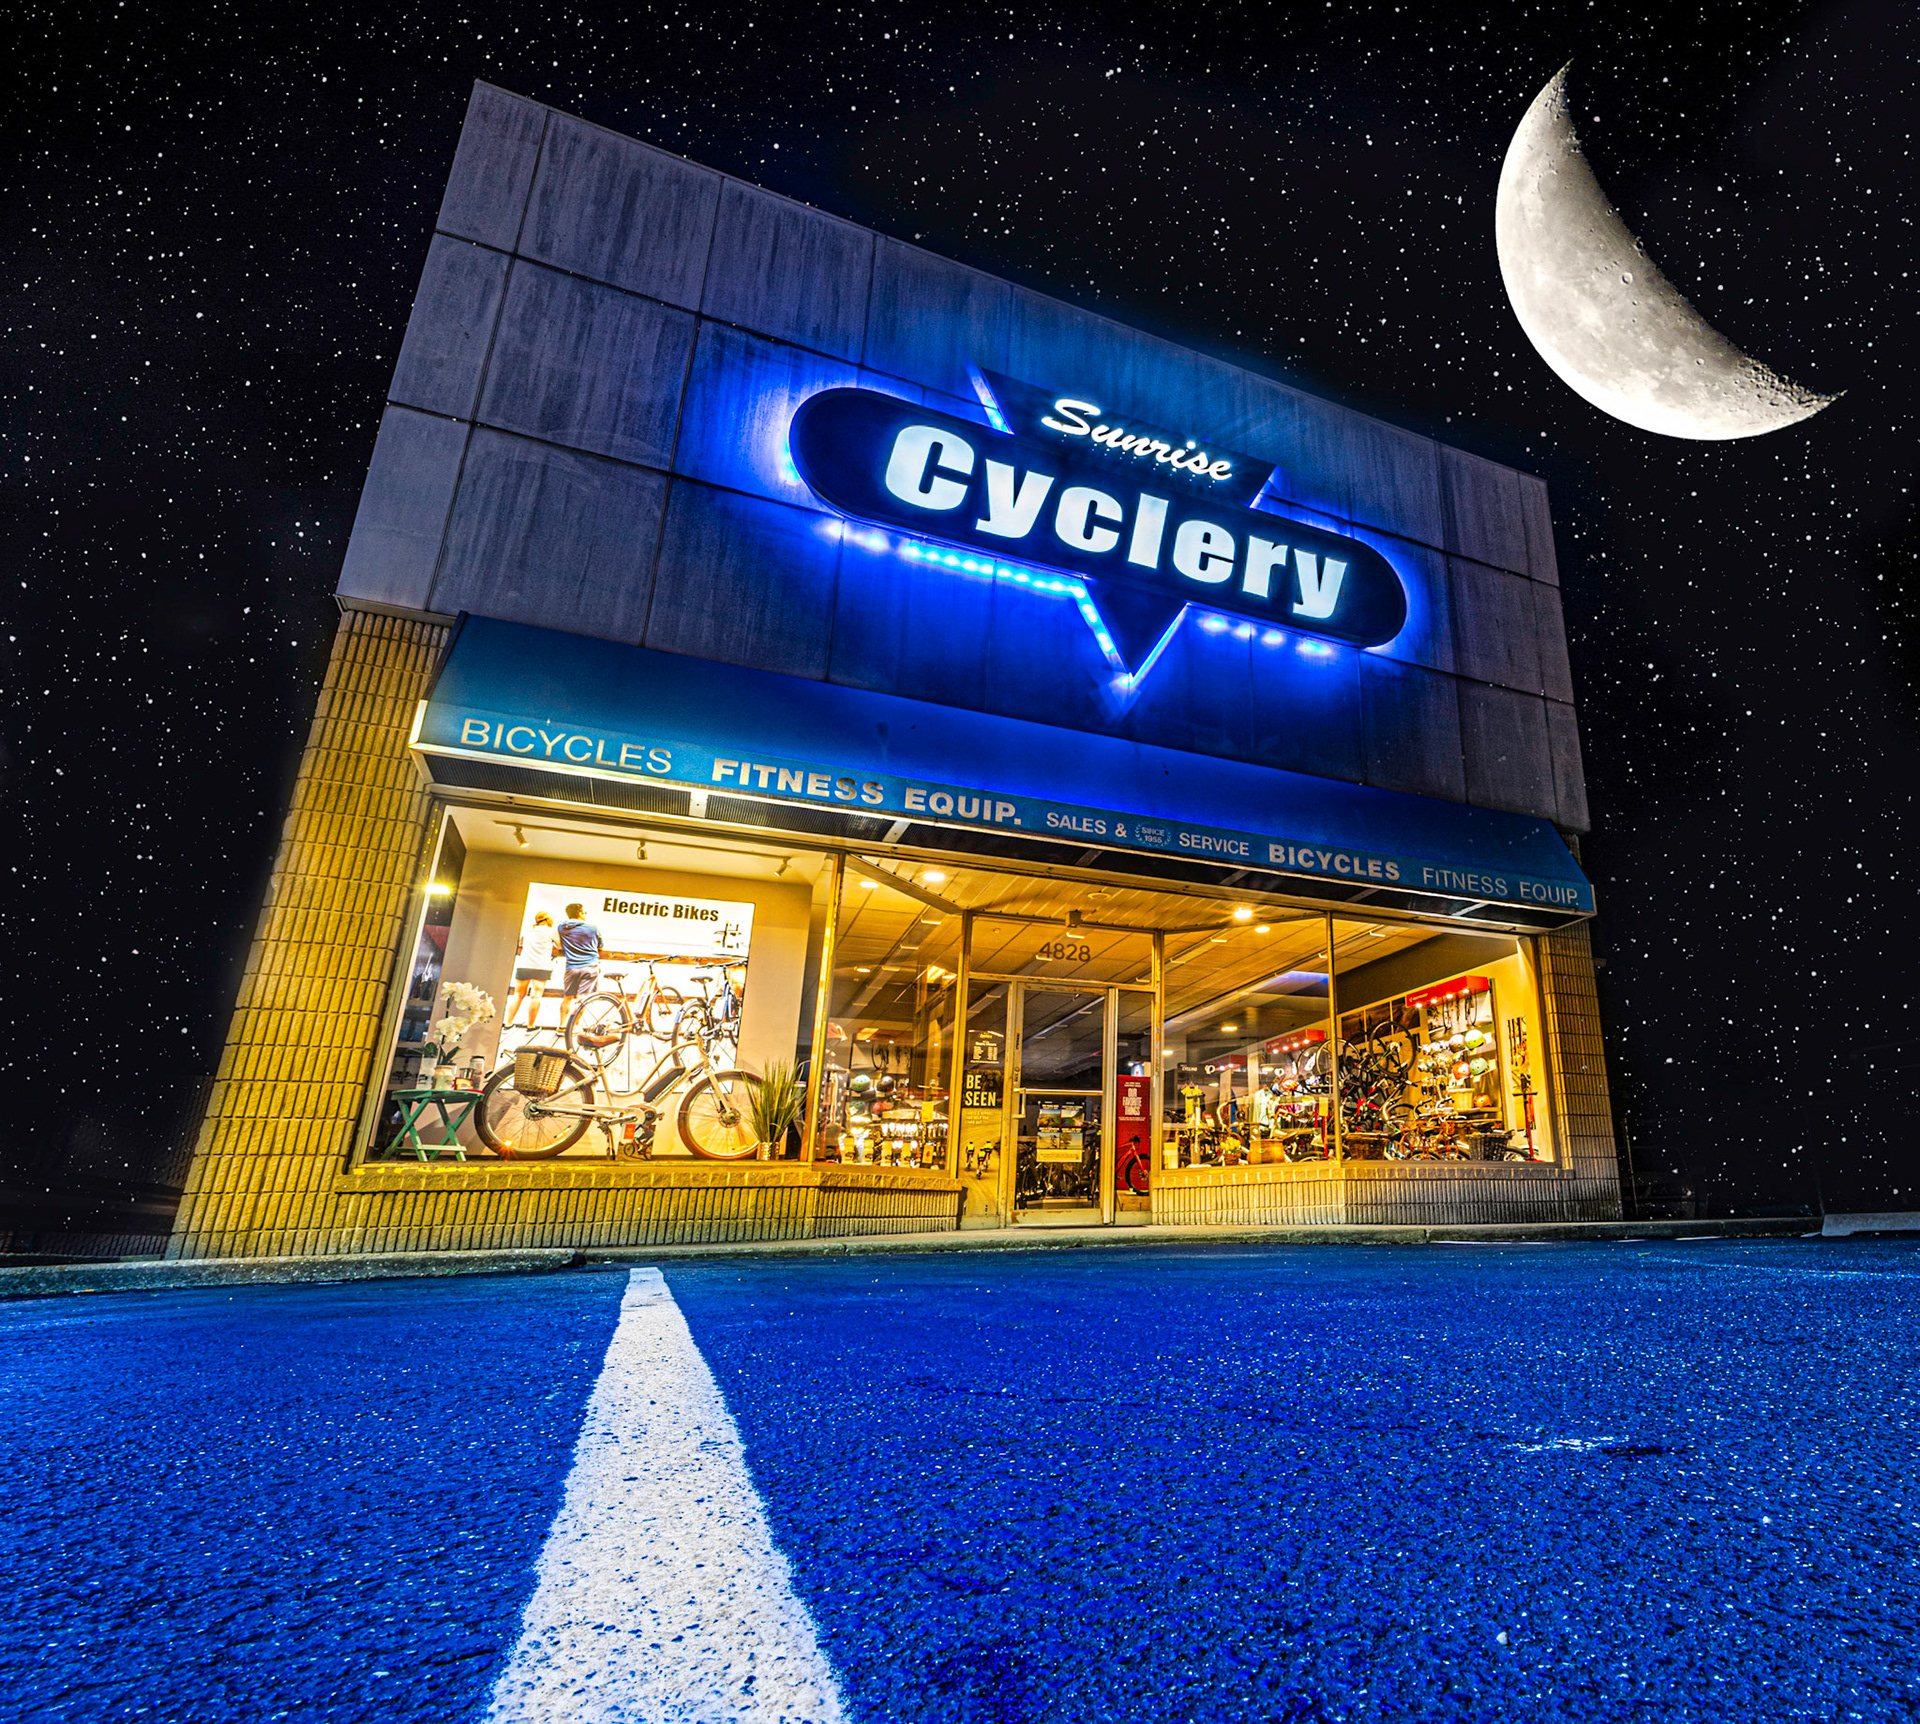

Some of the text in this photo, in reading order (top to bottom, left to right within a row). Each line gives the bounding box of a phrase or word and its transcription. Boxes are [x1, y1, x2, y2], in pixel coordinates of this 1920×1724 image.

[1041, 398, 1234, 481] Sunrise
[885, 424, 1347, 619] Cyclery
[460, 718, 672, 774] BICYCLES
[711, 758, 1022, 825] FITNESS EQUIP.
[1046, 812, 1250, 856] SALES & SERVICE
[1141, 826, 1165, 837] SINCE
[1268, 843, 1400, 880] BICYCLES
[1422, 867, 1580, 906] FITNESS EQUIP.
[603, 897, 719, 922] Electric Bikes
[1039, 941, 1091, 962] 4828
[965, 1091, 996, 1107] SEEN
[966, 1074, 982, 1090] BE
